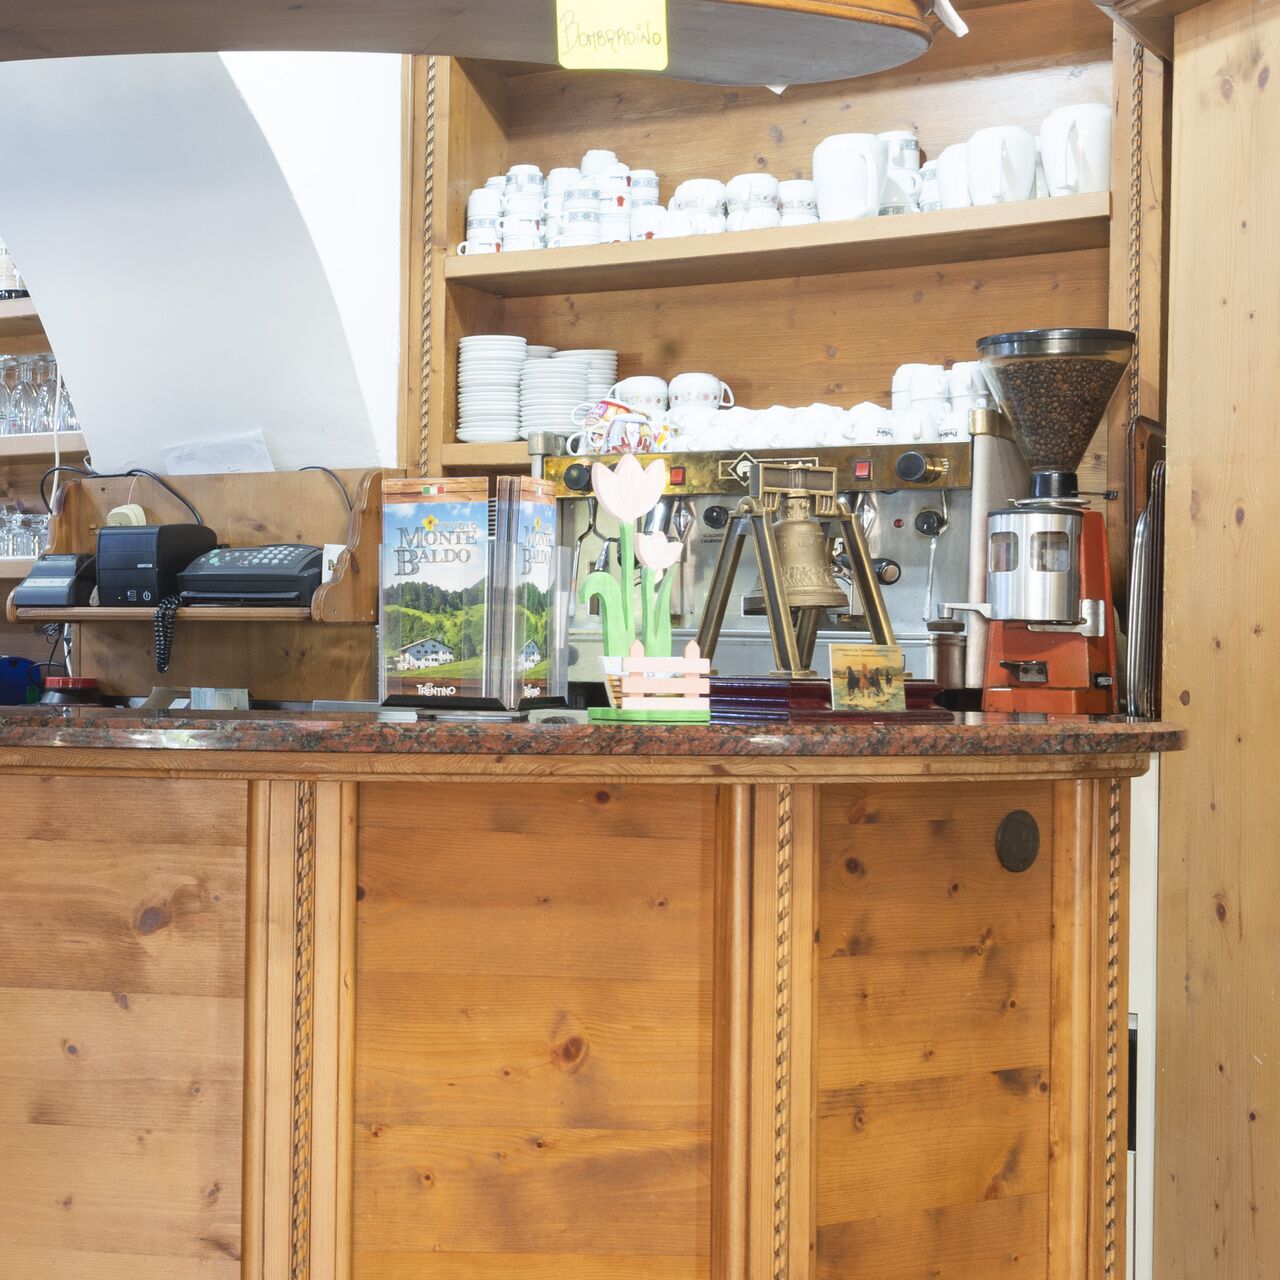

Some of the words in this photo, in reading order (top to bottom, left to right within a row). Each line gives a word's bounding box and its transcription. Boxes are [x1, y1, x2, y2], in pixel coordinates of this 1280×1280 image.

[396, 526, 478, 549] MONTE
[394, 548, 471, 577] BALDO
[416, 682, 456, 696] TRENTINO
